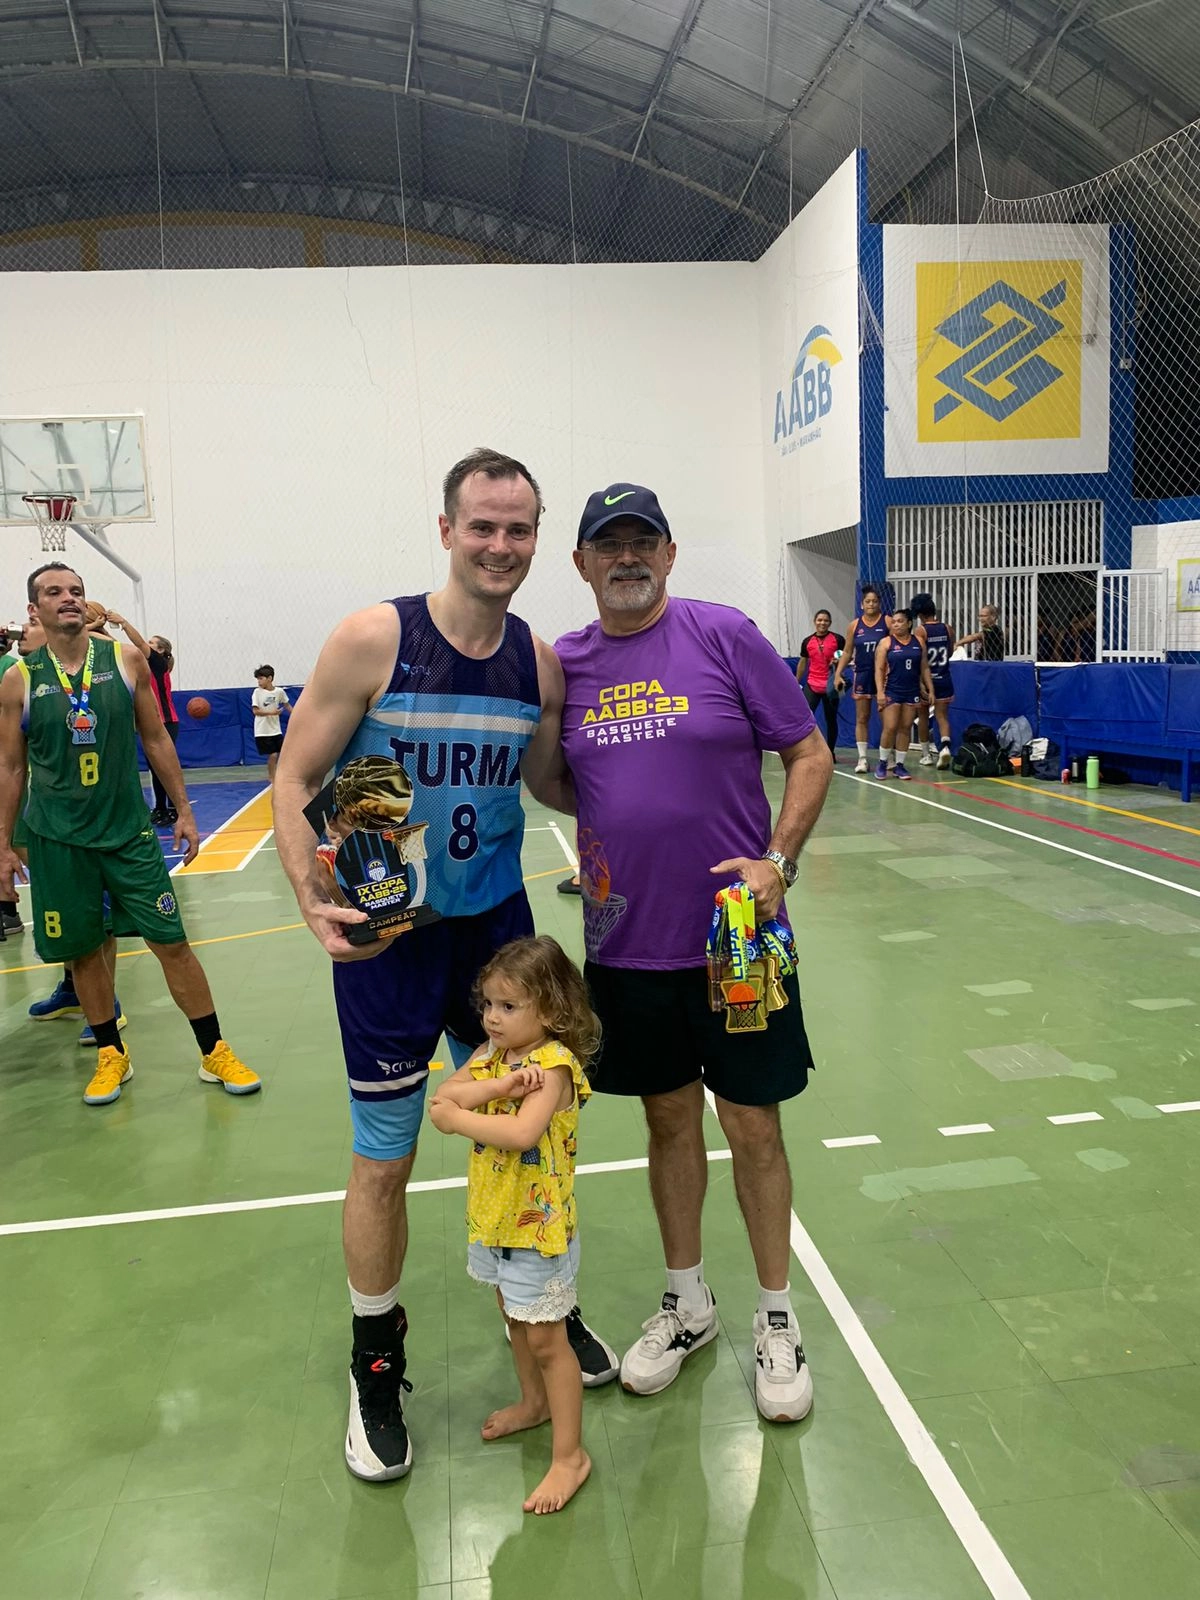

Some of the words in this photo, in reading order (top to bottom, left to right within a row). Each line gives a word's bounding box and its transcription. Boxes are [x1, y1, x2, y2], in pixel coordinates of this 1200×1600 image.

[774, 361, 833, 444] AABB
[1187, 579, 1200, 595] AA
[863, 641, 877, 653] 77
[928, 647, 948, 666] 23
[905, 659, 912, 670] 8
[599, 679, 665, 704] COPA
[587, 717, 677, 738] BASQUETE
[597, 729, 666, 746] MASTER
[79, 752, 99, 787] 8
[448, 802, 480, 862] 8
[357, 886, 371, 896] IX
[371, 877, 405, 892] COPA
[365, 892, 405, 907] BASQUETE
[371, 898, 401, 910] MASTER
[44, 911, 62, 938] 8
[369, 910, 417, 929] CAMPEÃO
